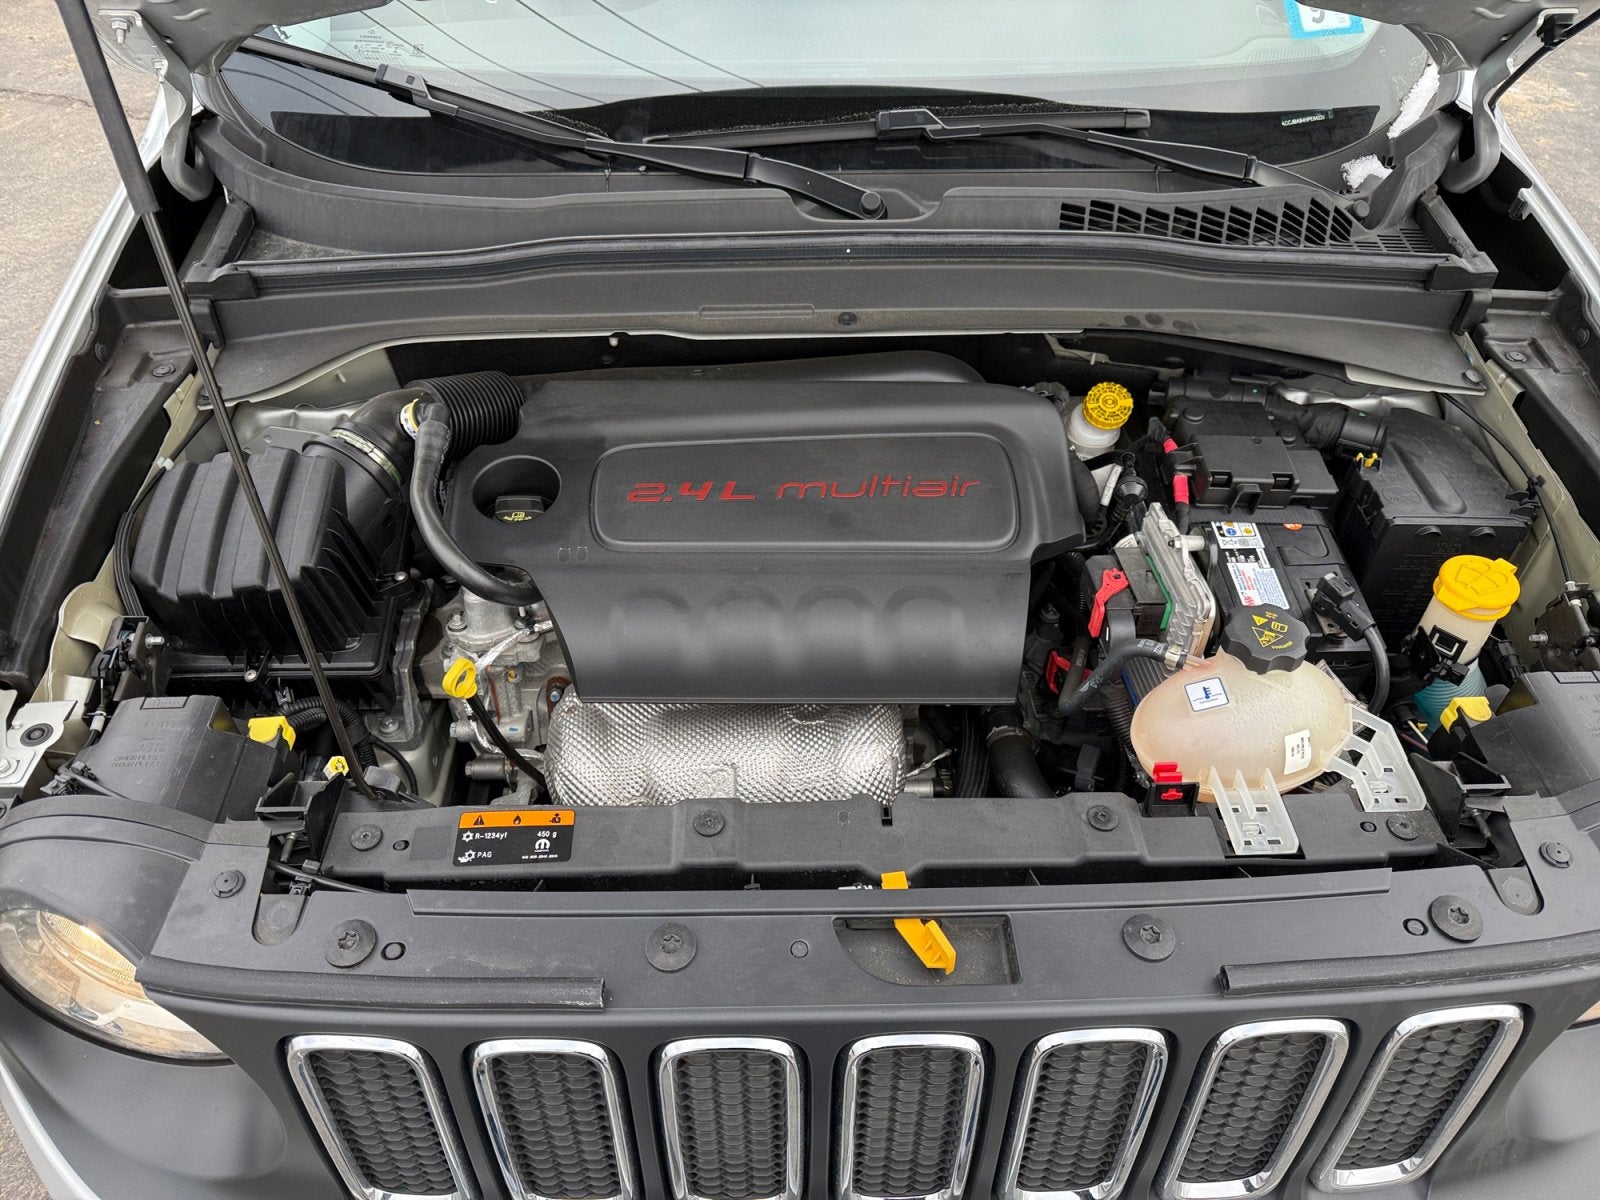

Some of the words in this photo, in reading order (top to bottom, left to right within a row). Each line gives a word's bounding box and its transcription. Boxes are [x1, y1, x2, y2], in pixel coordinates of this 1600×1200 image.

[776, 474, 980, 499] multiair
[474, 831, 508, 840] R-1234yf
[537, 830, 551, 838] 450
[552, 831, 558, 839] g
